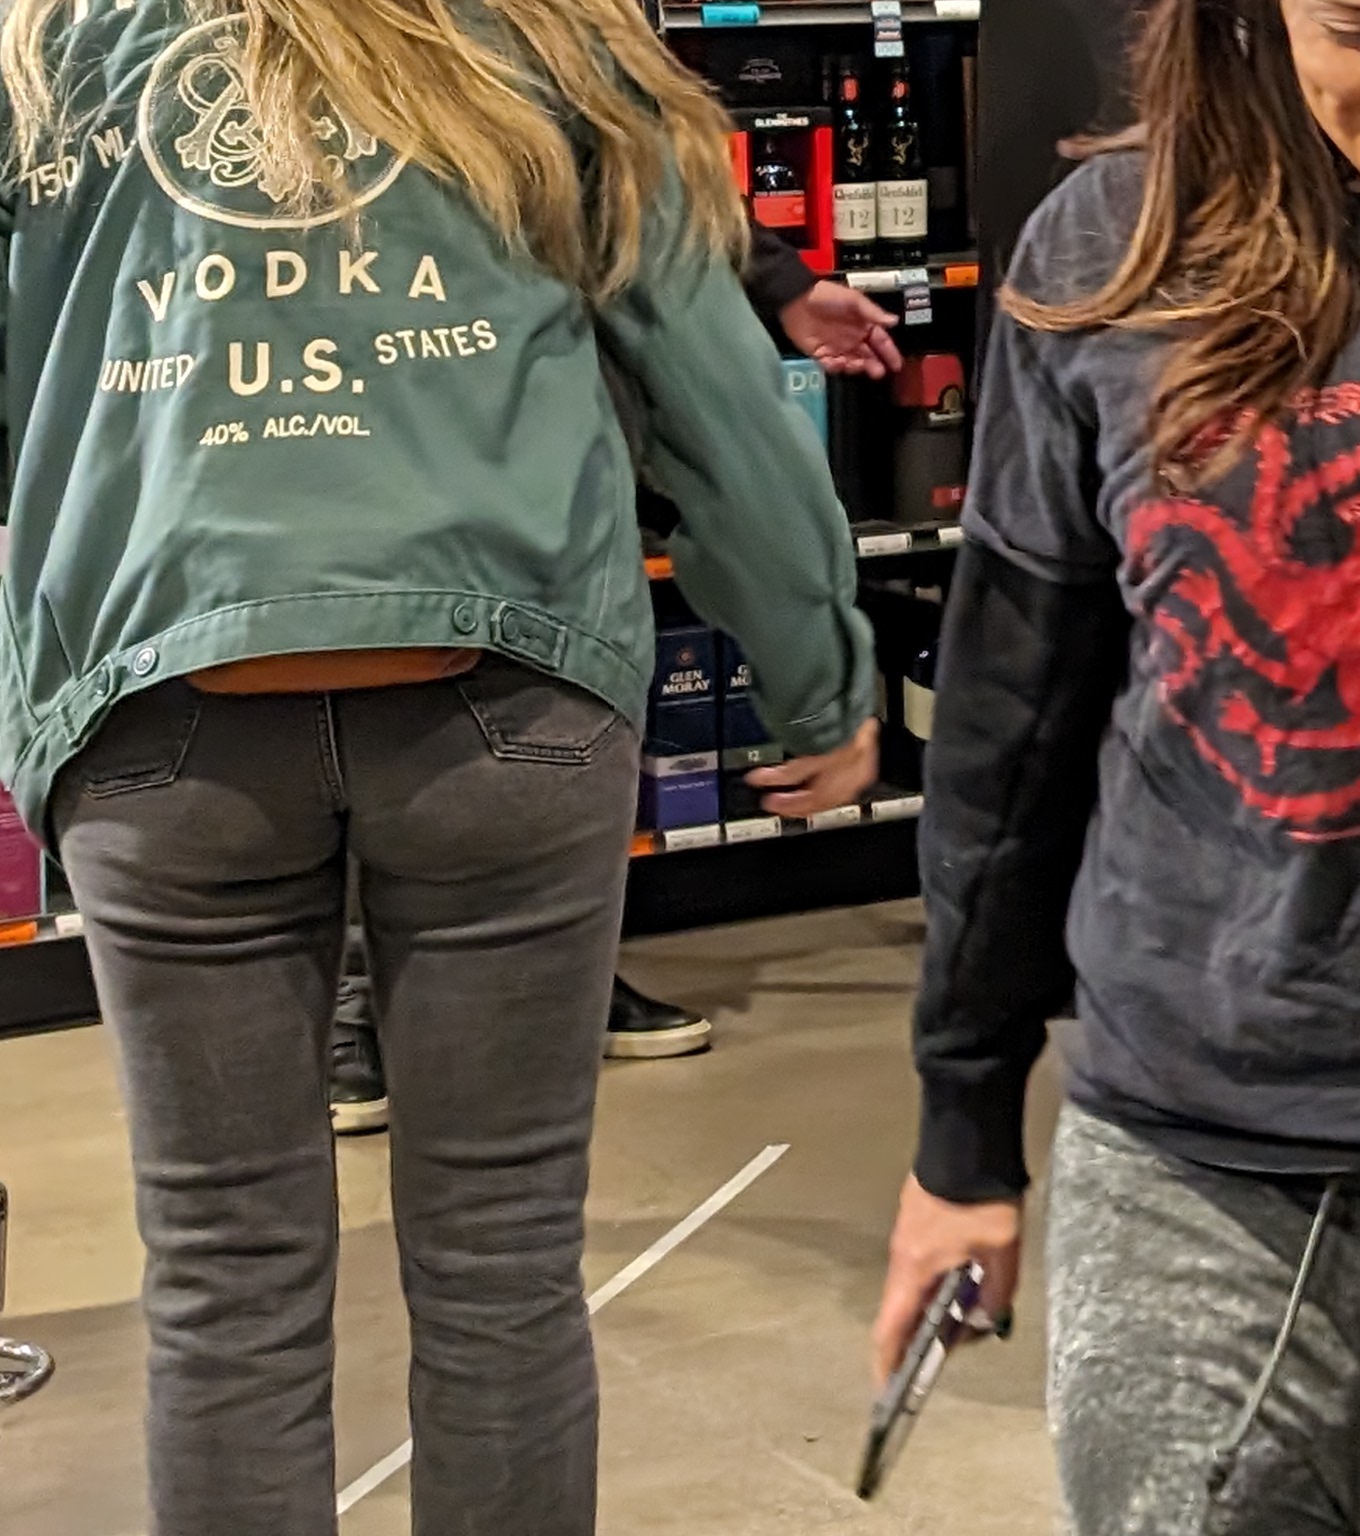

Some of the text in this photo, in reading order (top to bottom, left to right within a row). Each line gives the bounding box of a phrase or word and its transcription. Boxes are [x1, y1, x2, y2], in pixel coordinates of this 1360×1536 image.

[849, 208, 869, 229] 12
[894, 206, 914, 227] 12
[136, 249, 448, 323] VODKA
[100, 319, 499, 397] UNITED U.S. STATES
[199, 421, 250, 447] 40%
[669, 669, 703, 684] GLEN
[661, 679, 710, 696] MORAY
